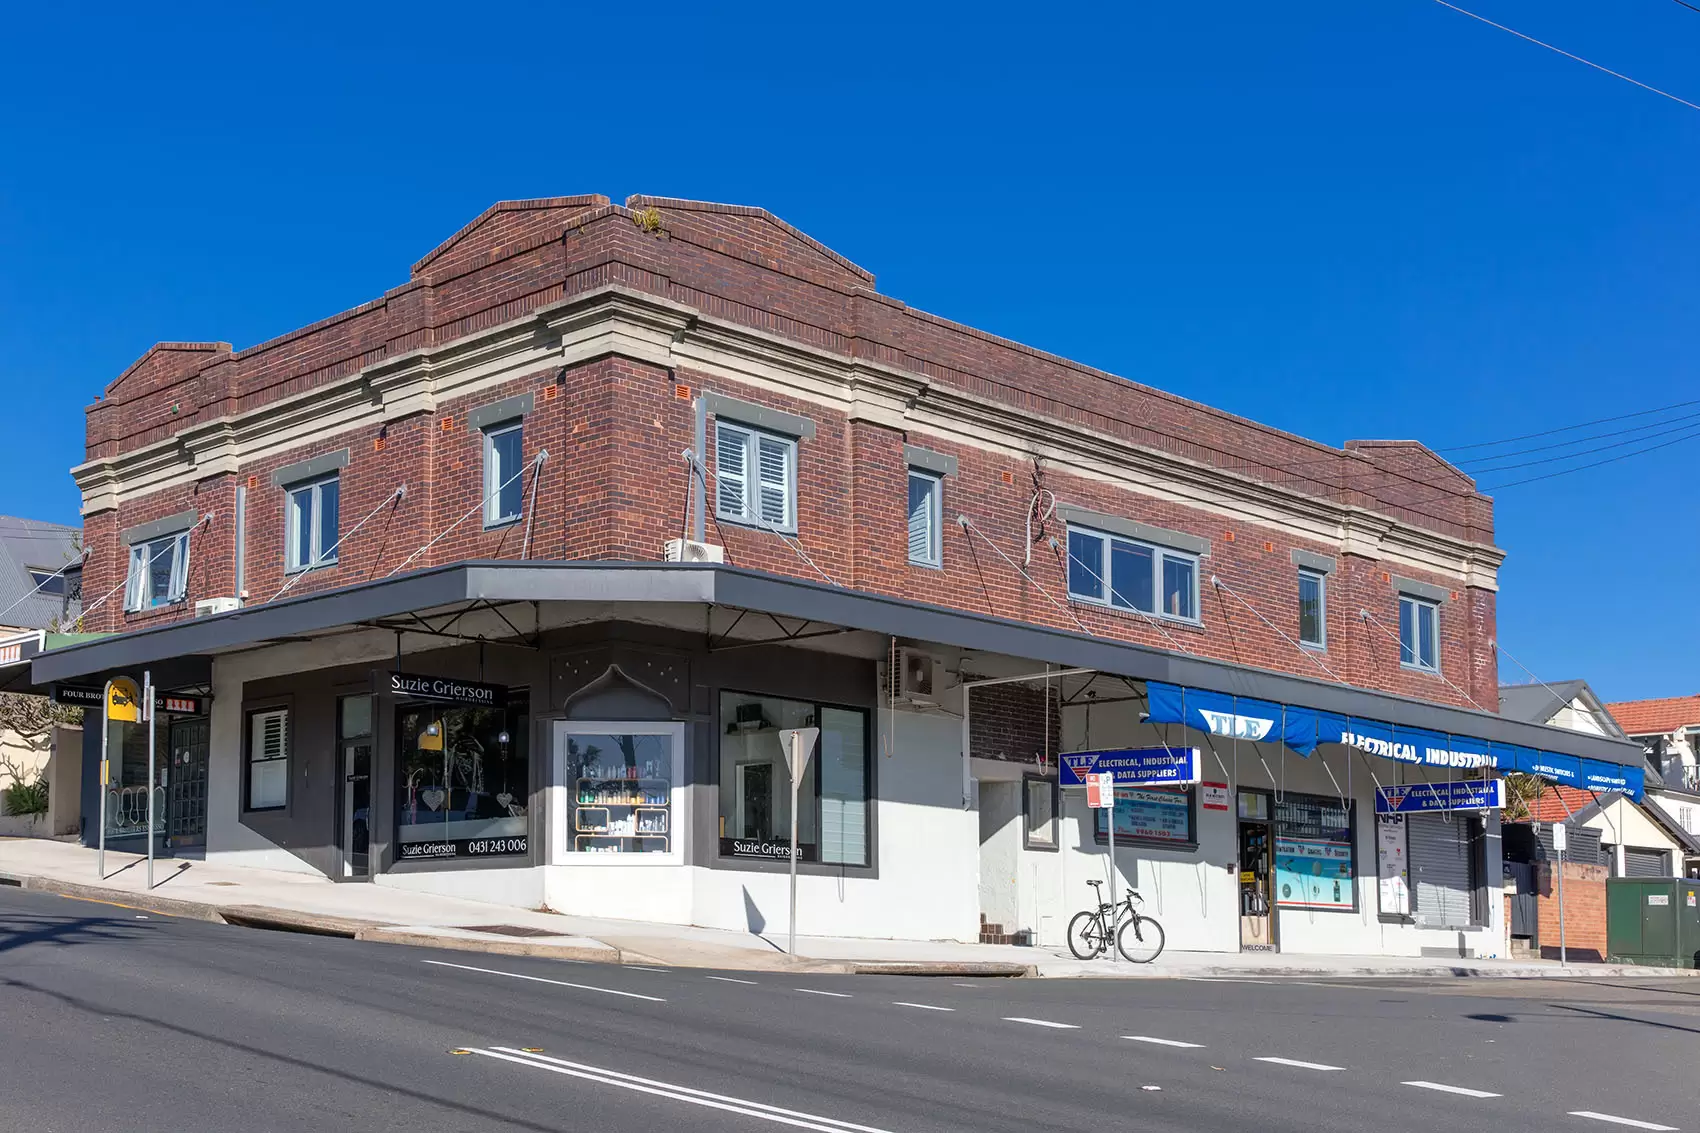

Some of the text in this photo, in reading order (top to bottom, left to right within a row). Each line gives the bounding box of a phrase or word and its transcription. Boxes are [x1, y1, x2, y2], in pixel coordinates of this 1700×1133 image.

[391, 674, 493, 700] Suzie Grierson
[63, 690, 84, 699] FOUR
[1211, 713, 1262, 739] TLE
[1340, 731, 1423, 765] ELECTRICAL,
[1067, 756, 1188, 768] TLE ELECTRICAL, INDUSTRIAL
[1117, 771, 1136, 779] DATA
[1138, 768, 1178, 778] SUPPLIERS
[1429, 799, 1447, 807] DATA
[1448, 797, 1485, 806] SUPPLIERS
[1376, 813, 1403, 824] NHP
[402, 838, 527, 855] Suzie Grierson 0431 243 006
[734, 841, 803, 856] Suzie Griersn
[1241, 944, 1272, 952] WELCOME
